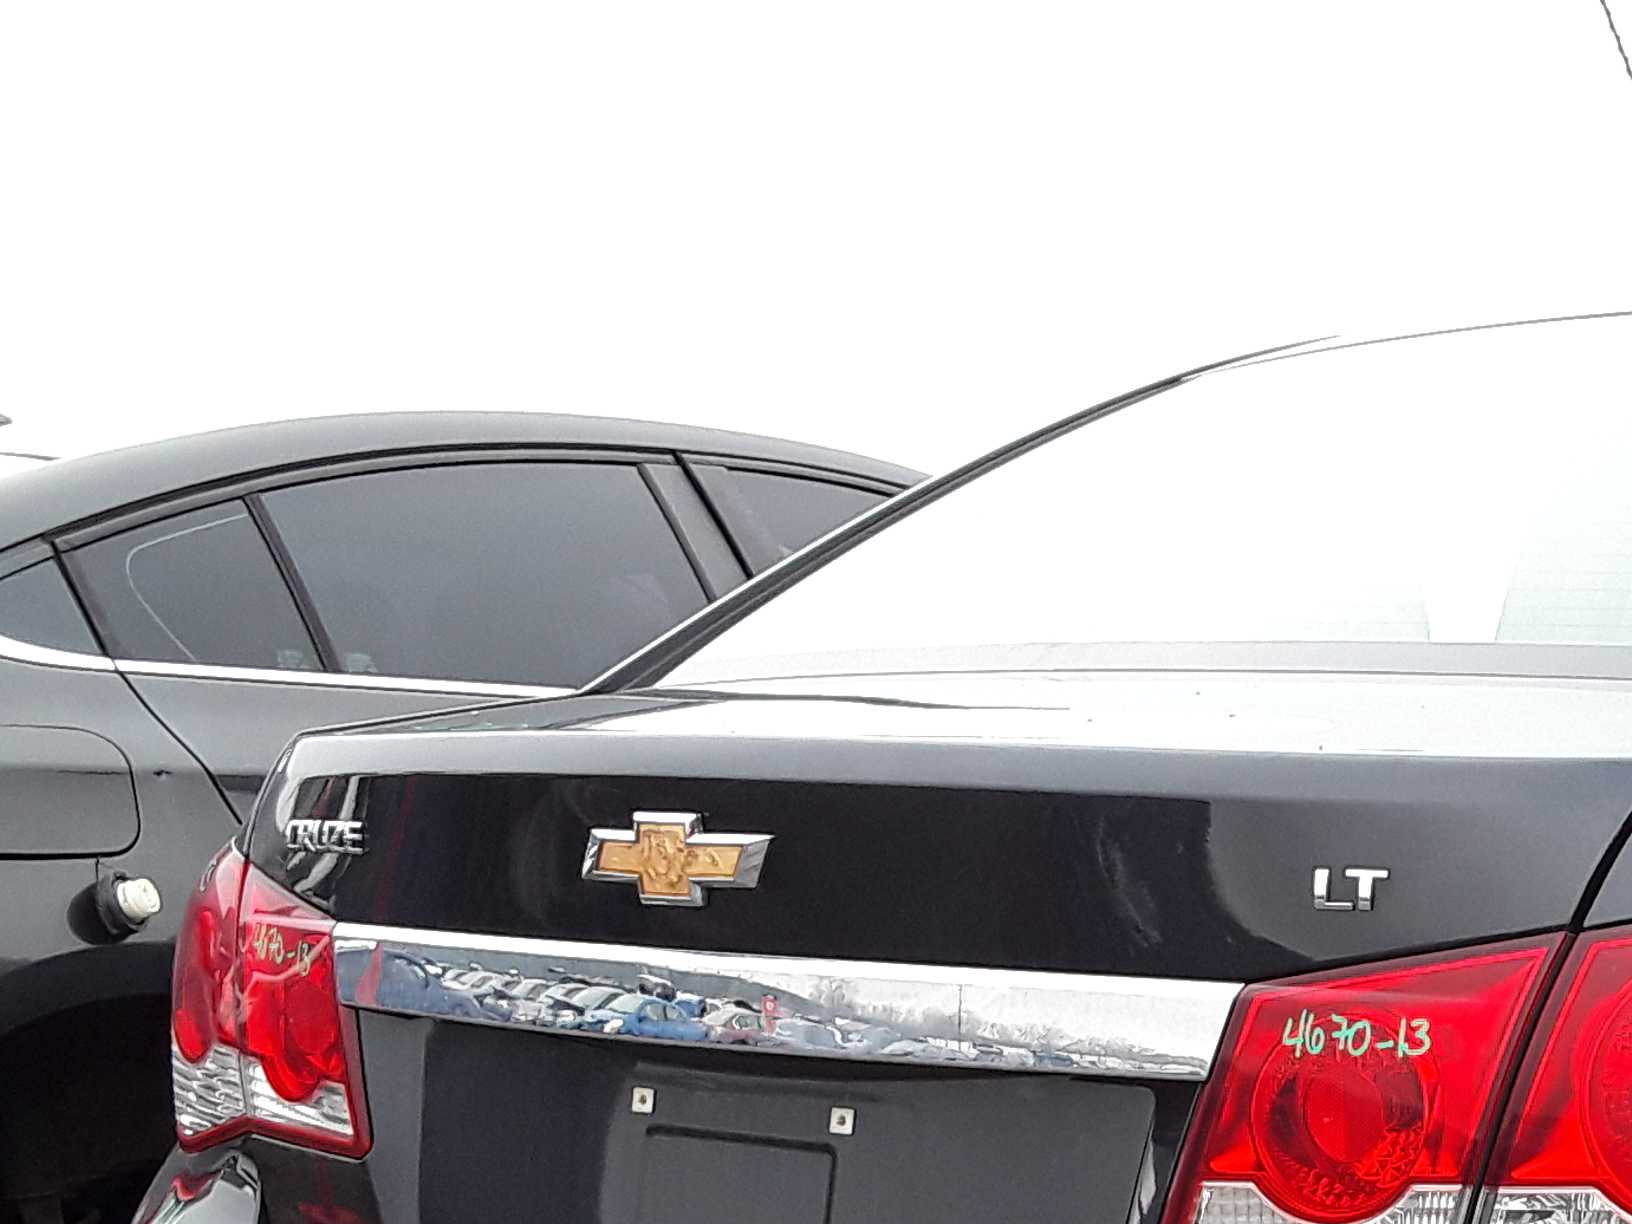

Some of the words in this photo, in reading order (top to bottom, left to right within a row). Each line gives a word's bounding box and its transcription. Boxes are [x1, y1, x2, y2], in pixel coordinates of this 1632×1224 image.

[284, 818, 363, 855] CRUZE
[1313, 867, 1389, 912] LT
[1281, 1007, 1432, 1059] 4670-13
